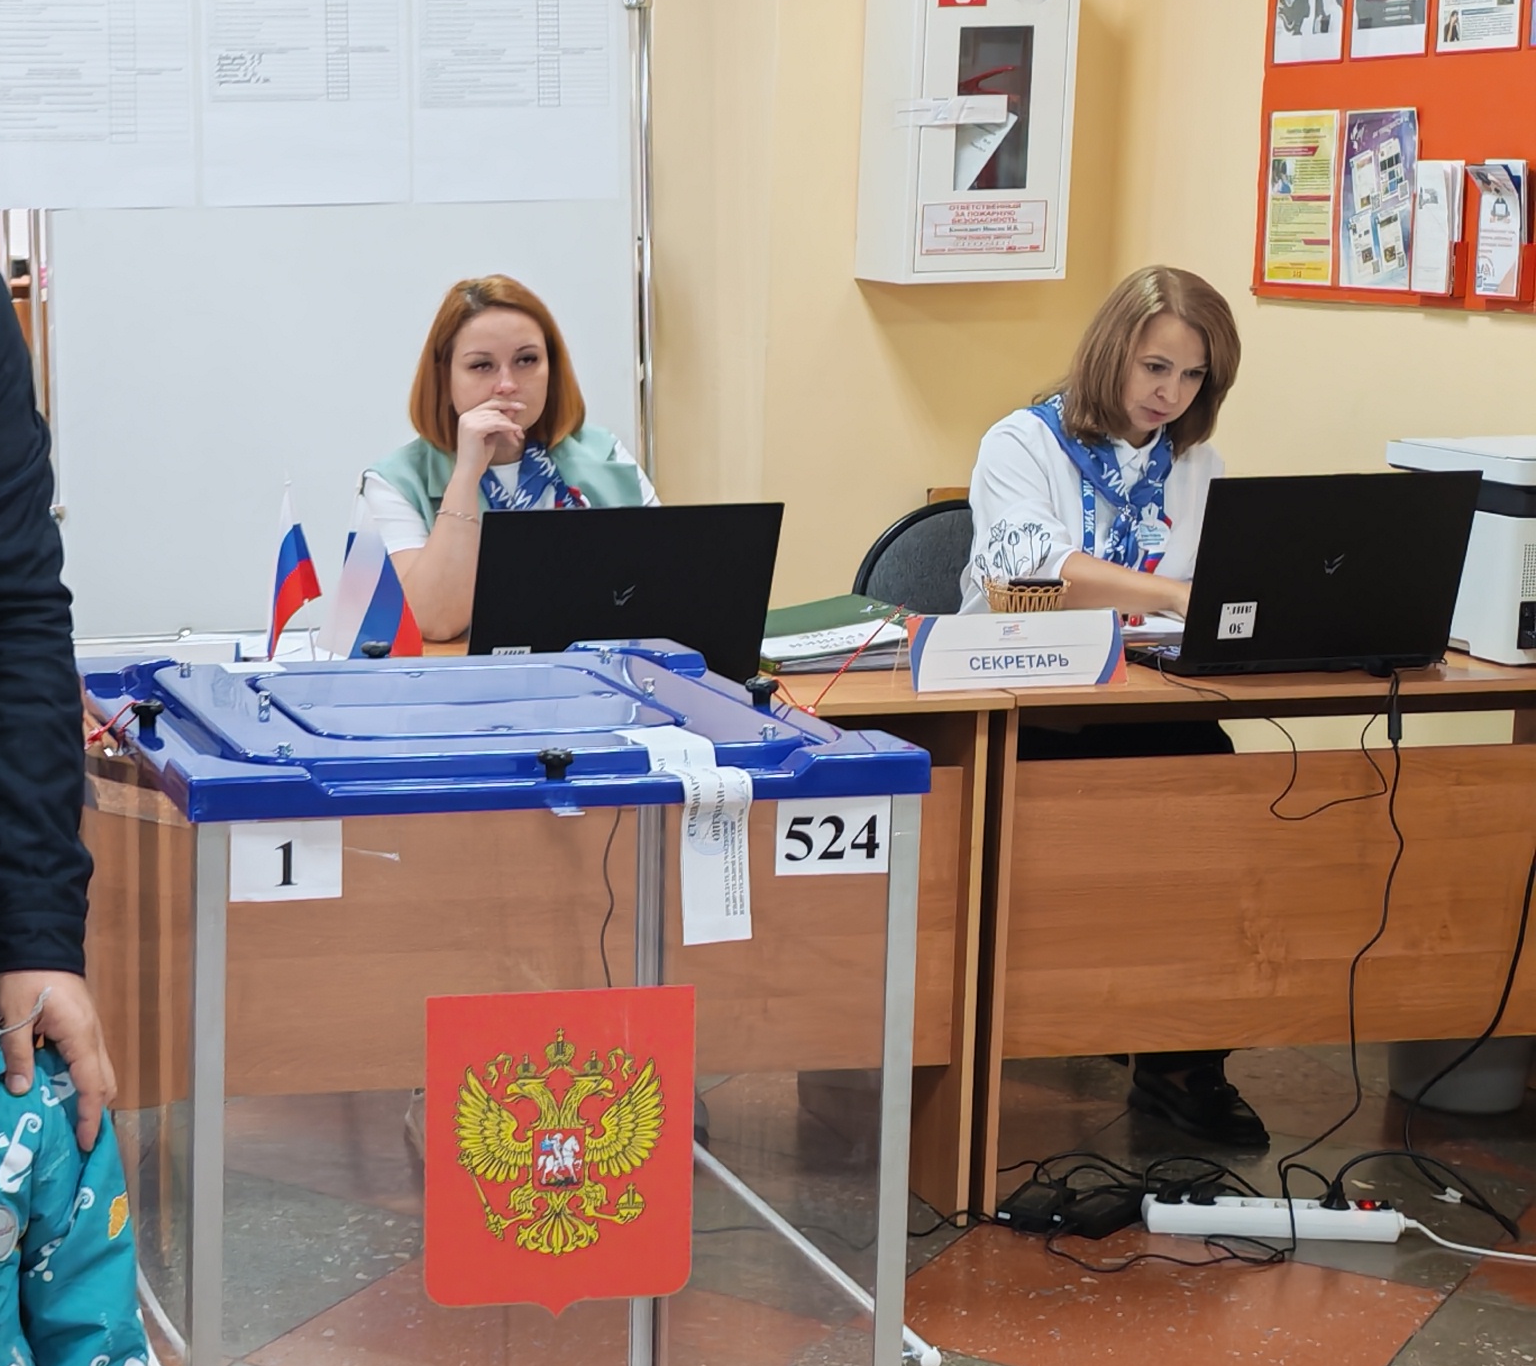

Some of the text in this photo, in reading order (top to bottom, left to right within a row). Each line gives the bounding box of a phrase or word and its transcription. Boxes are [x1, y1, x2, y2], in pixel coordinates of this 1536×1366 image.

[1084, 509, 1095, 536] УИК
[1229, 622, 1244, 635] 30
[969, 653, 1069, 670] СЕКРЕТАРЬ
[275, 840, 297, 887] 1
[783, 815, 880, 861] 524
